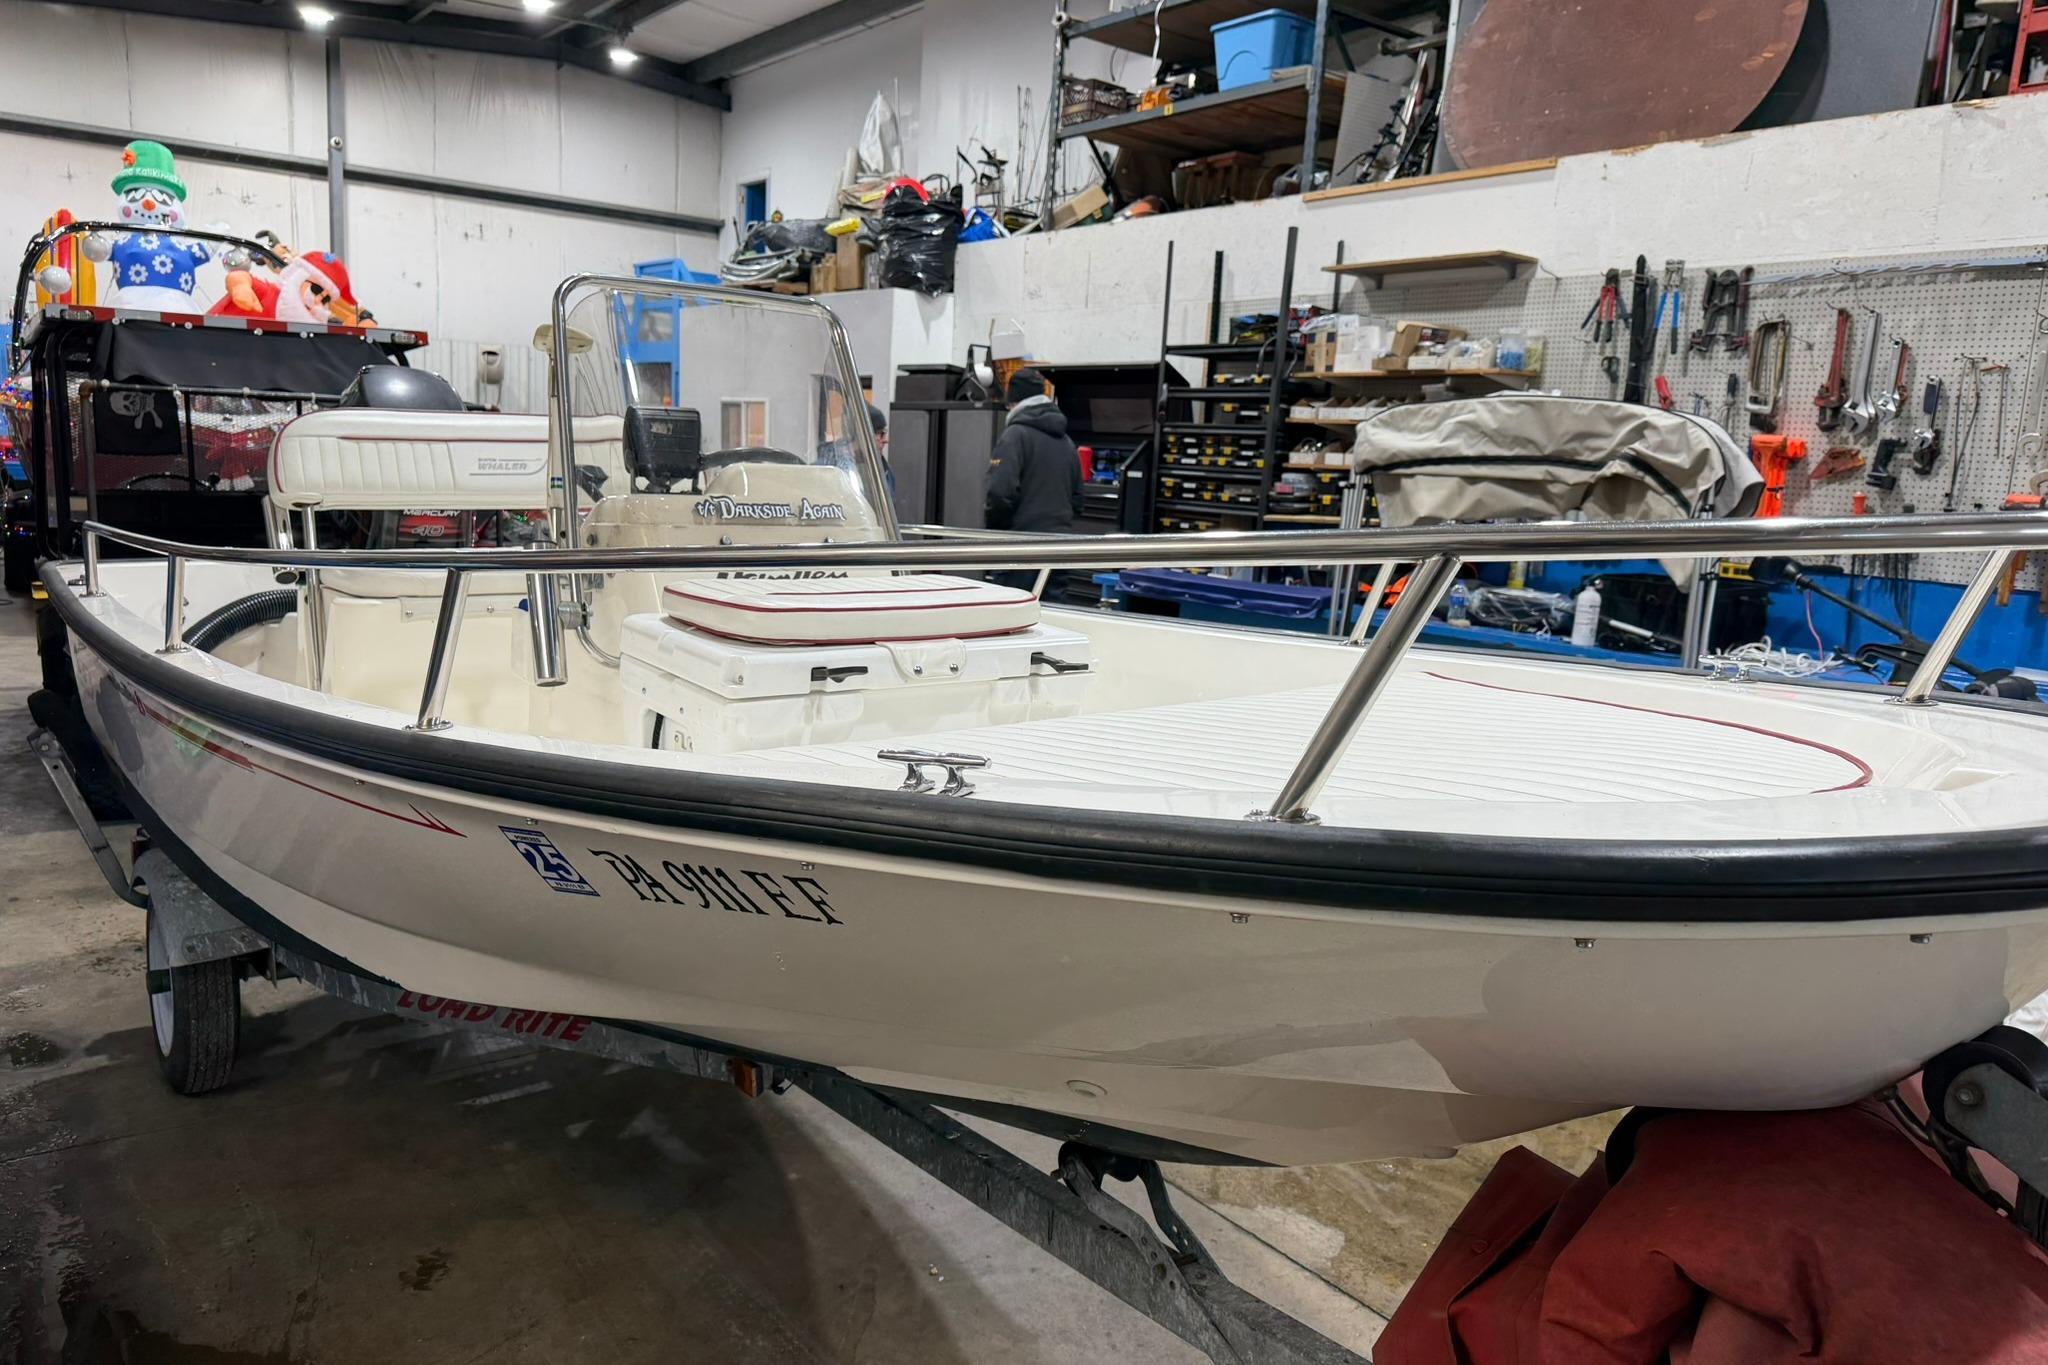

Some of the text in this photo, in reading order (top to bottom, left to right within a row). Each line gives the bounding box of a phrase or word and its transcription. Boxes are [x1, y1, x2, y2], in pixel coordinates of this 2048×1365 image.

[478, 462, 528, 471] WHALER
[402, 508, 461, 517] MERCURY
[411, 524, 445, 537] 40
[516, 842, 581, 882] 25
[586, 848, 845, 925] PA 9111 EF
[396, 990, 593, 1043] LOAD RITE
